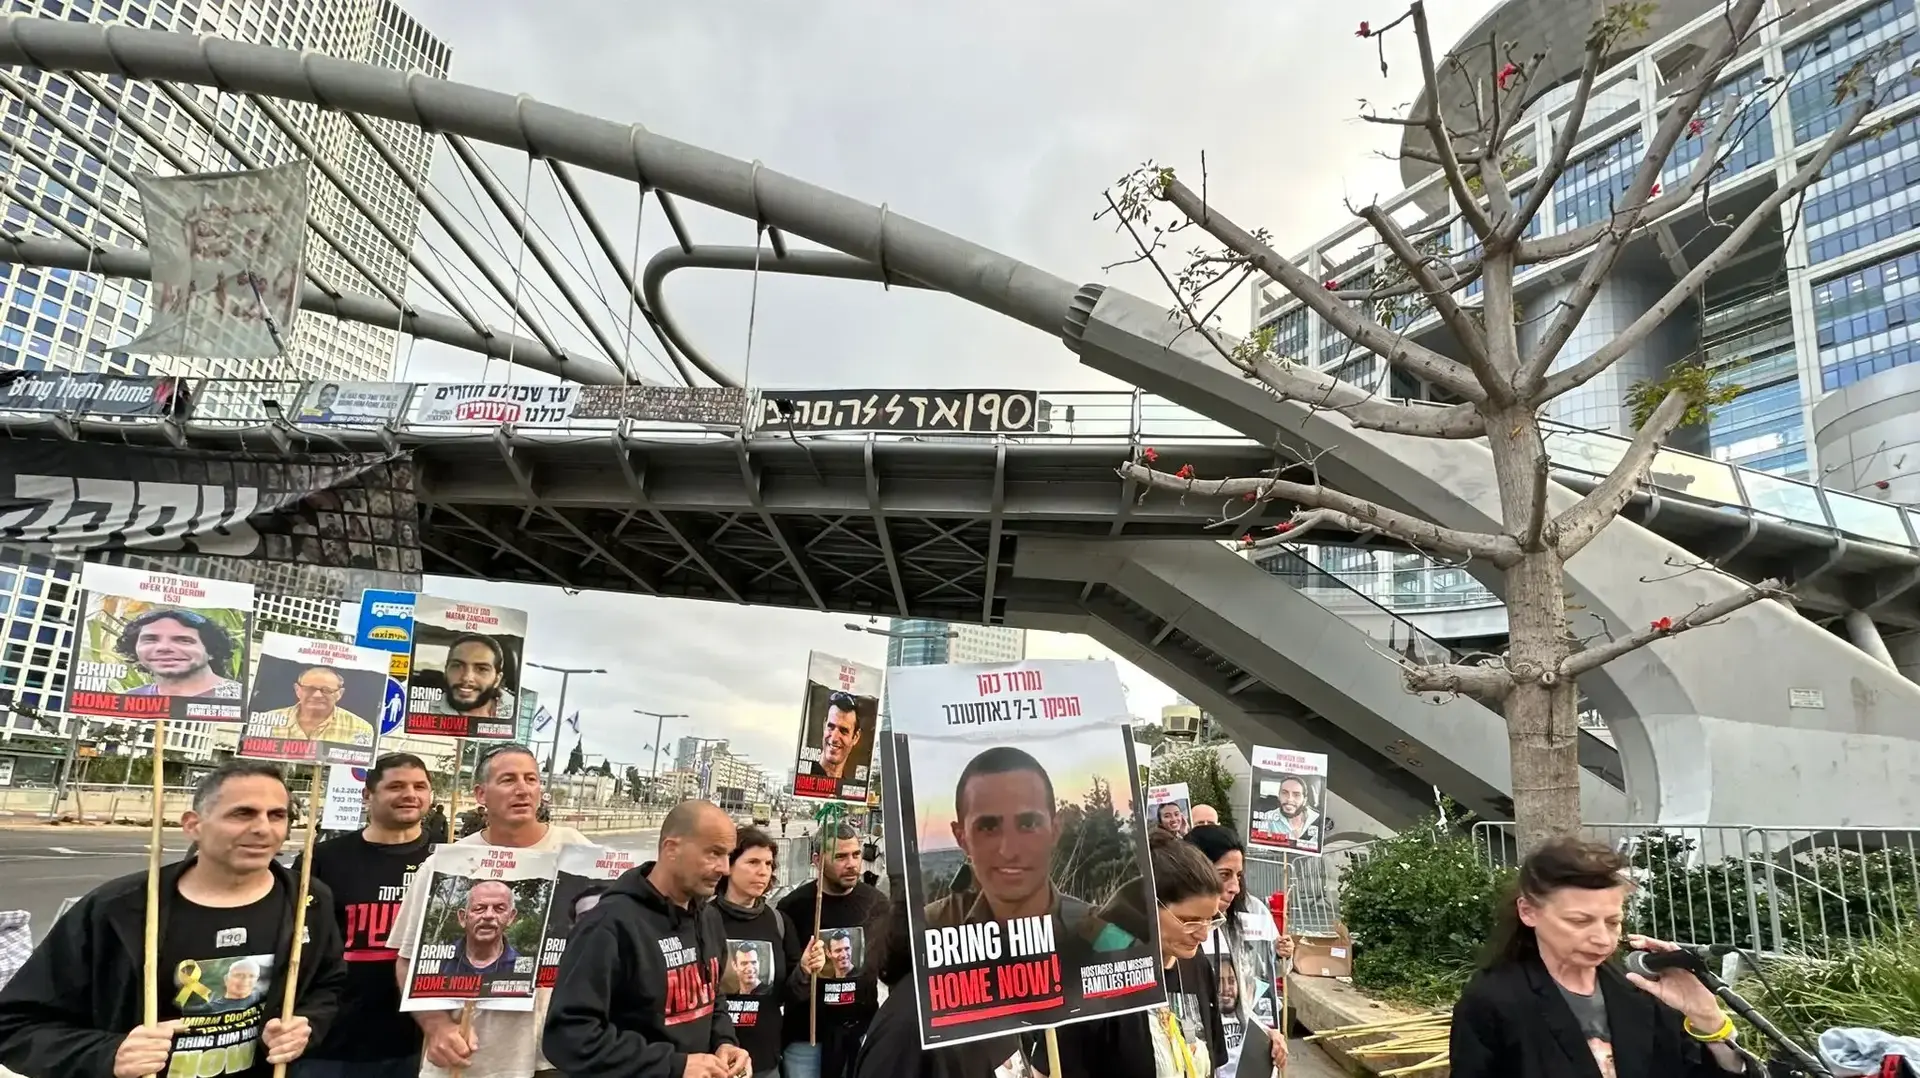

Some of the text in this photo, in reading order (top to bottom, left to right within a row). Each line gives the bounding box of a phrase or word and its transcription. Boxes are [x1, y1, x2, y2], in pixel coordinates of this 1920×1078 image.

[8, 376, 56, 400] Bring
[56, 376, 104, 399] Them
[102, 380, 153, 403] Home
[435, 385, 486, 400] חוזרים
[548, 386, 571, 402] עד
[458, 402, 566, 422] כולנו חטופים
[140, 582, 206, 598] OFER KALDERON
[446, 612, 466, 621] MATAN
[76, 661, 127, 679] BRING
[74, 675, 108, 692] HIM
[976, 670, 1042, 696] נמרוד כהן
[411, 686, 442, 700] BRING
[71, 692, 170, 712] HOME NOW!
[410, 700, 430, 713] HIM
[250, 711, 288, 726] BRING
[942, 696, 1081, 725] הופקר ב-7 באוקטובר
[409, 716, 468, 730] HOME NOW!
[247, 726, 272, 737] HIM
[243, 738, 316, 754] HOME NOW!
[800, 748, 821, 762] BRING
[798, 760, 812, 774] HIM
[796, 776, 815, 790] HOME
[816, 778, 836, 792] NOW!
[1253, 811, 1280, 821] BRING
[1252, 820, 1268, 829] HIM
[480, 859, 516, 868] PERI CHAIM
[596, 860, 613, 868] DOLEV
[379, 886, 406, 901] ביתה
[545, 938, 566, 952] BRI
[658, 936, 682, 953] BRING
[924, 914, 1056, 968] BRING HIM
[420, 944, 455, 960] BRING
[664, 950, 683, 968] THEM
[417, 960, 440, 974] HIM
[1081, 956, 1154, 978] HOSTAGES AND MISSING
[415, 974, 481, 991] HOME NOW!
[928, 953, 1064, 1012] HOME NOW!
[1082, 967, 1155, 995] FAMILIES FORUM
[824, 993, 840, 1002] HOME
[743, 1001, 760, 1012] DROR
[176, 1026, 258, 1050] BRING HIM HOM
